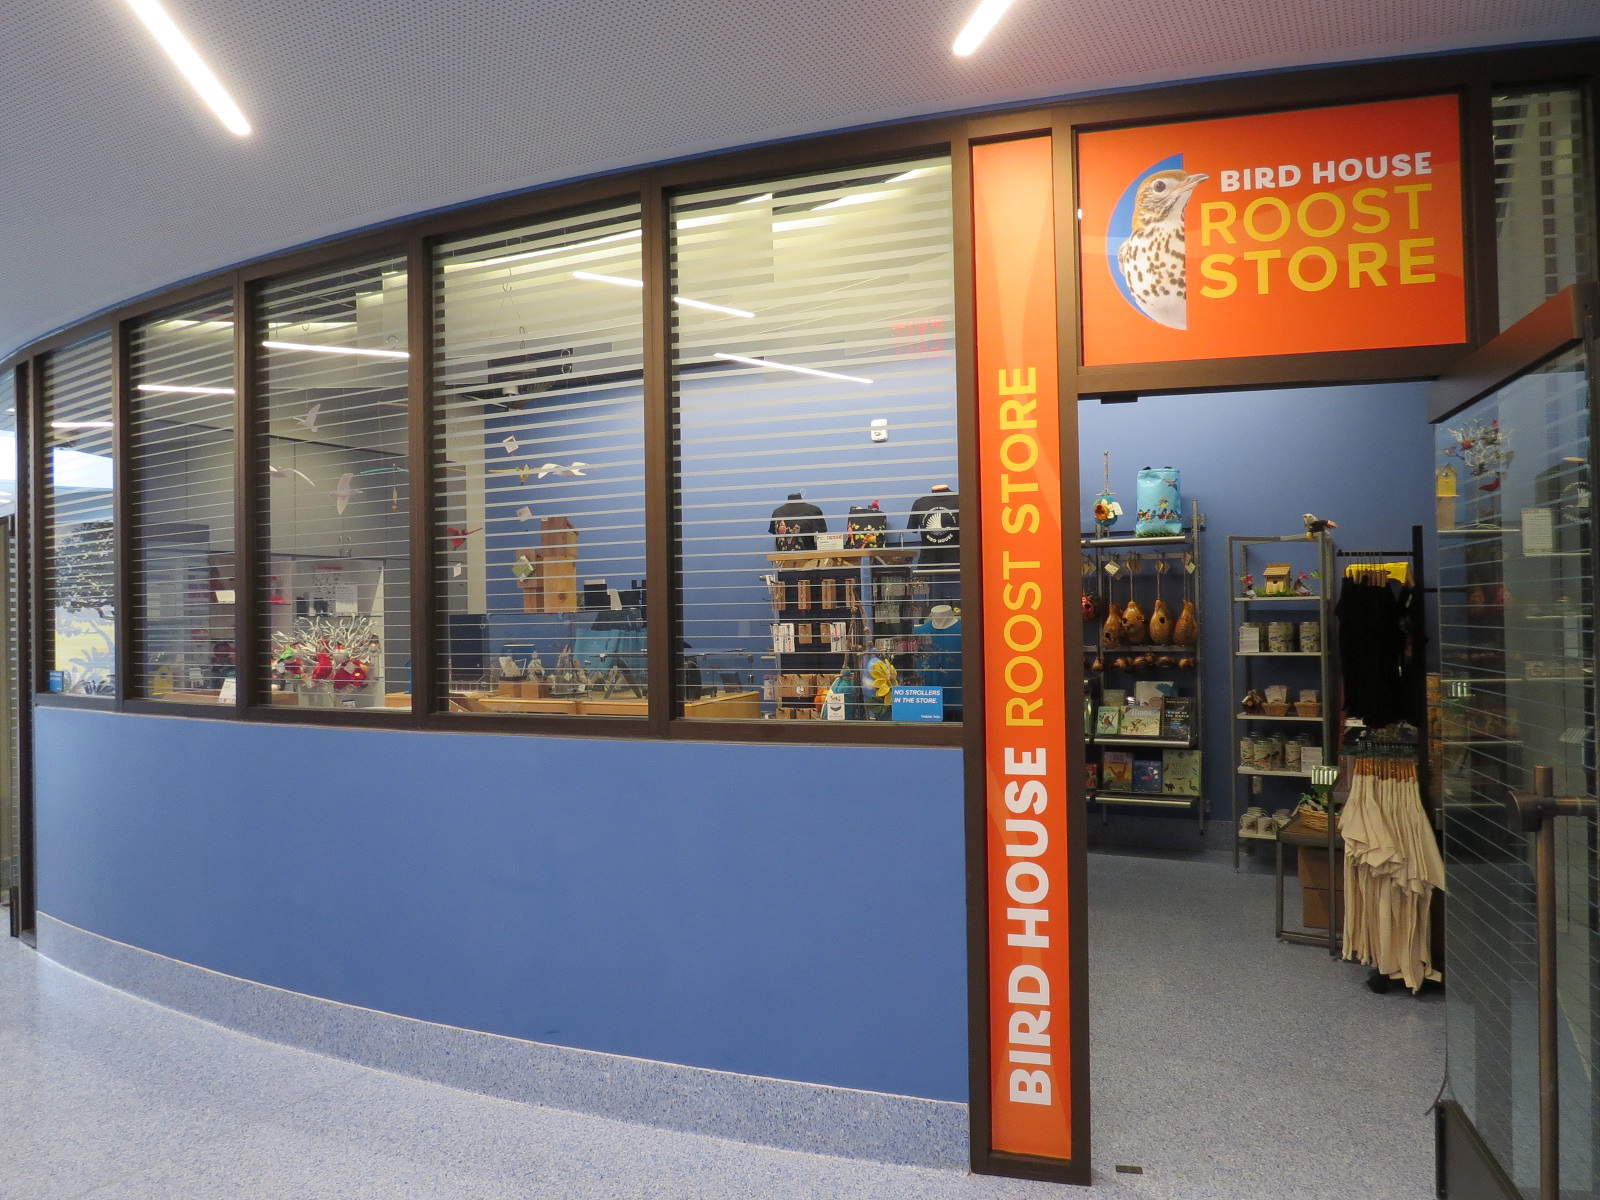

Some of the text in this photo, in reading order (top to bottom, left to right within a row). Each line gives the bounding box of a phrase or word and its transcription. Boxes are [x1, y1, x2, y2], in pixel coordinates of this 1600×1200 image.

[1220, 151, 1433, 193] BIRD HOUSE
[1200, 183, 1433, 247] ROOST
[1199, 237, 1436, 299] STORE
[937, 533, 954, 543] HOUSE
[998, 366, 1052, 1106] BIRD HOUSE ROOST STORE
